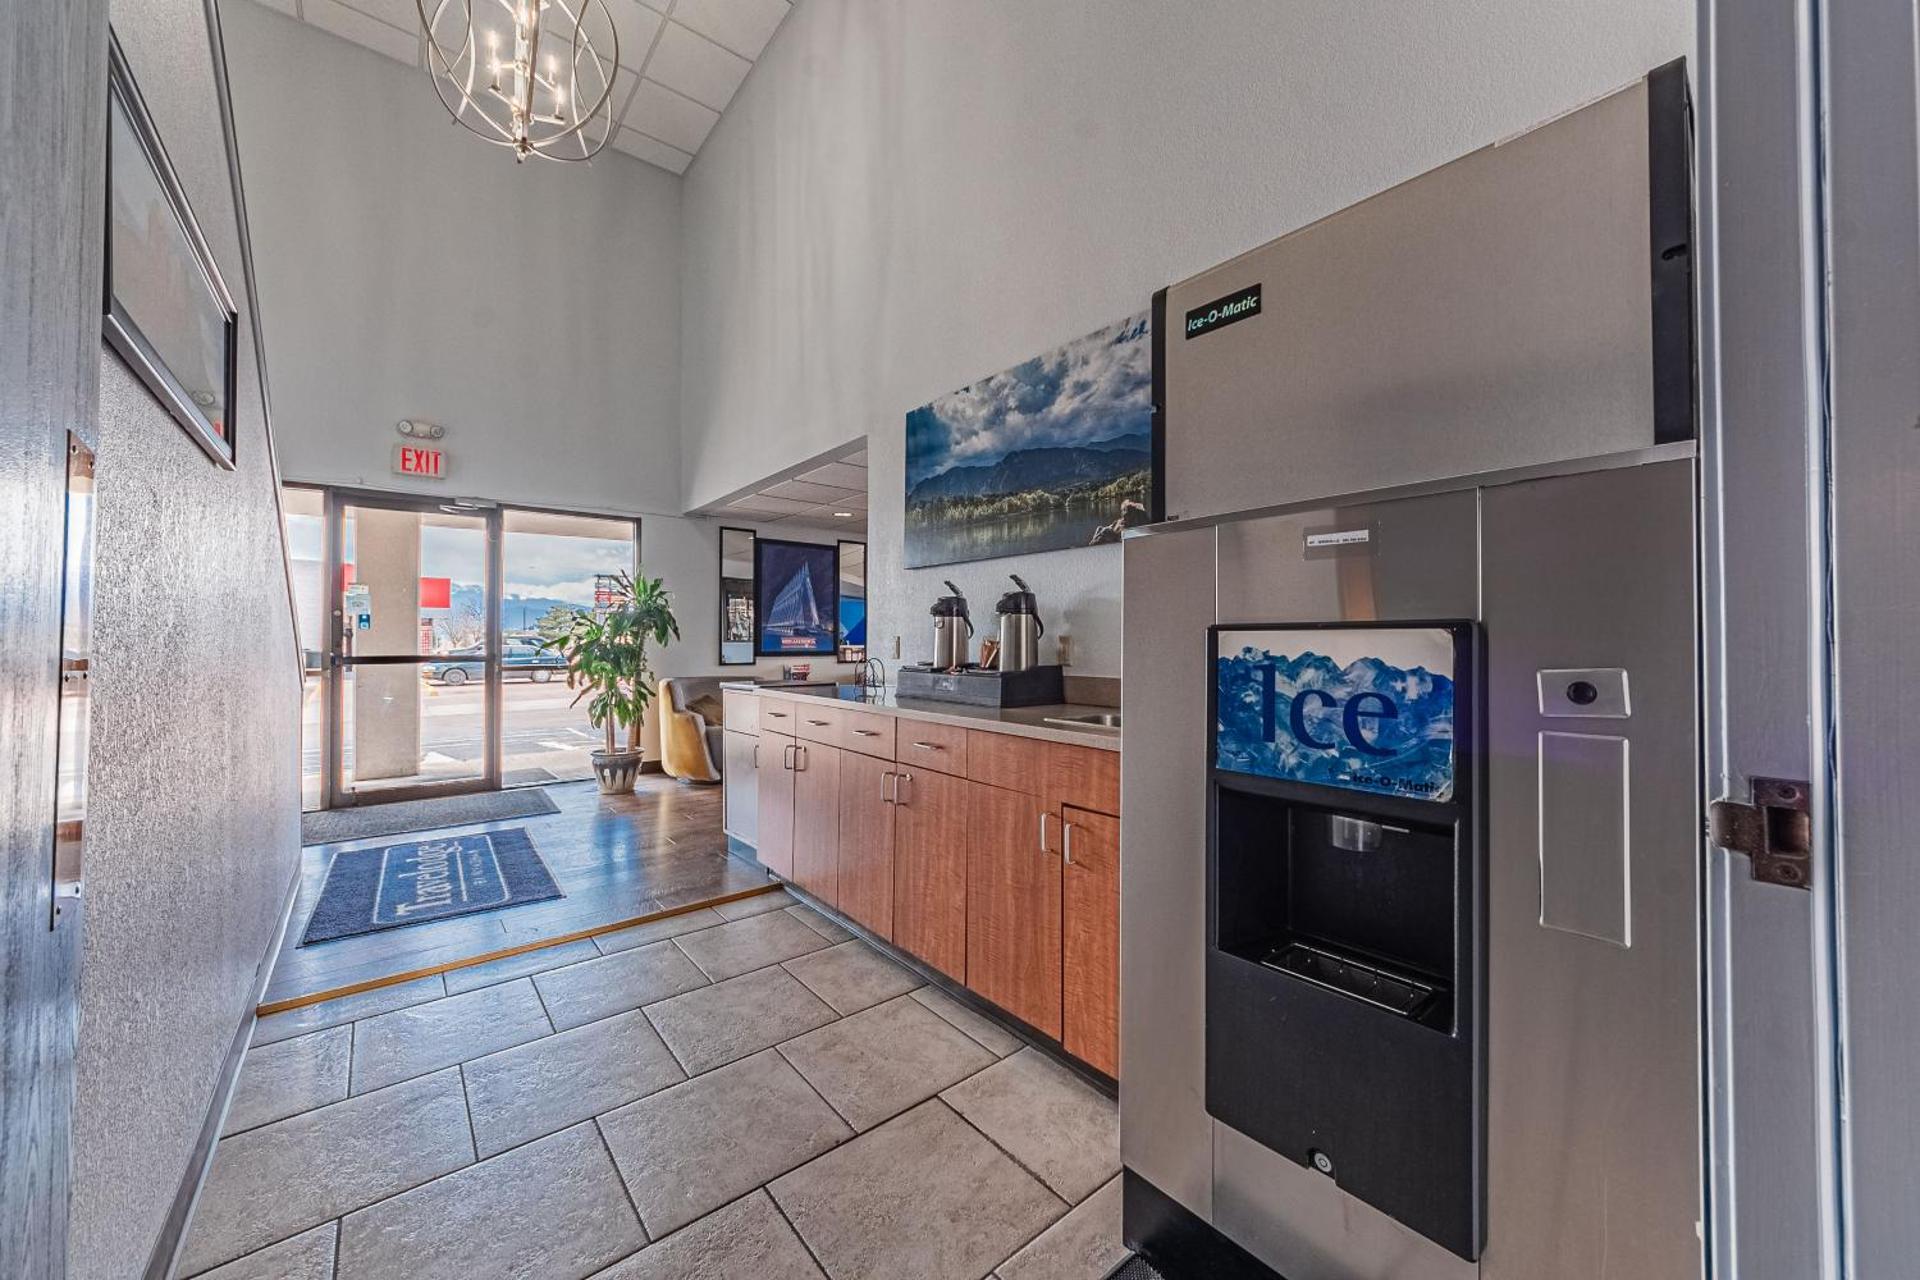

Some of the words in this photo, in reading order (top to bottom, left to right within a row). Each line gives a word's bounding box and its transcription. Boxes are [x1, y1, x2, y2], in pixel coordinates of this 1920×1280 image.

[1187, 296, 1258, 331] Ice-O-Matic
[401, 447, 442, 475] EXIT
[1253, 663, 1399, 757] Ice
[396, 841, 462, 915] Travelodge
